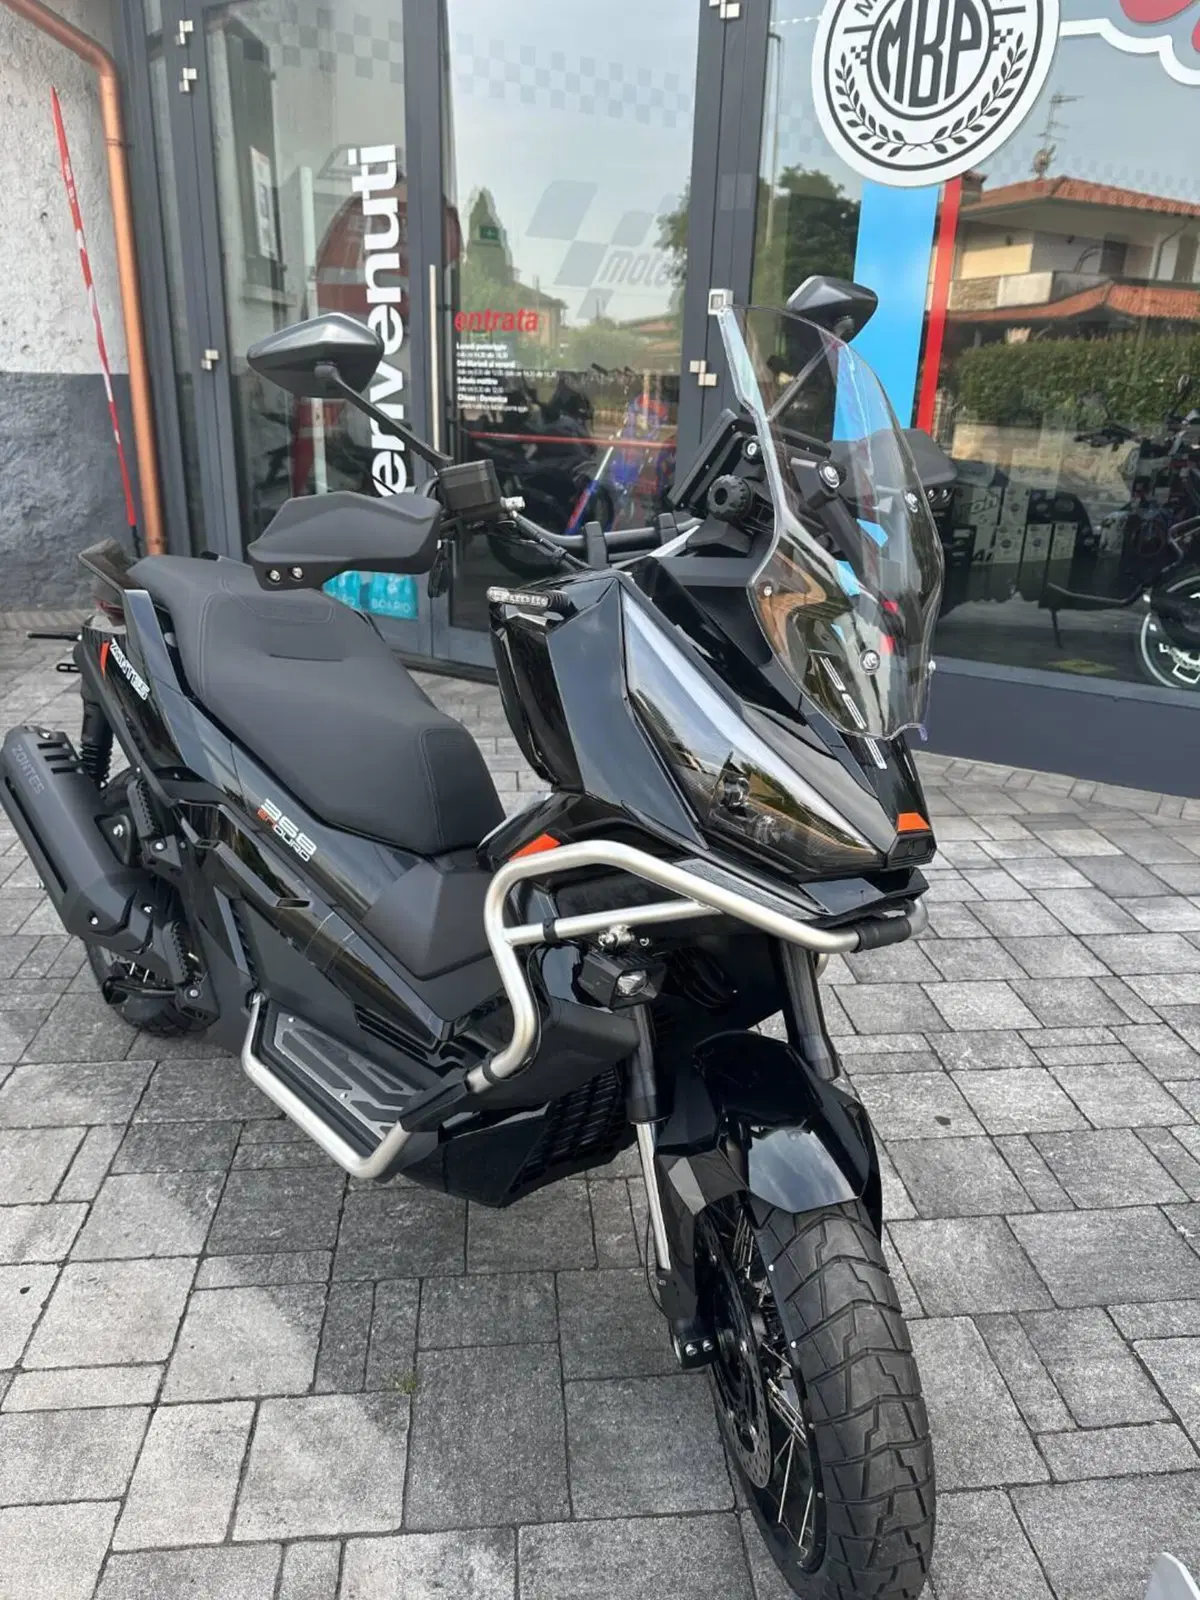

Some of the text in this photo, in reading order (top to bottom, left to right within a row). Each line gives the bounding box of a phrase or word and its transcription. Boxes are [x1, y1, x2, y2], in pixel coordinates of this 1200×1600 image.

[877, 0, 983, 108] MBP
[347, 143, 407, 497] envenuti
[454, 308, 539, 333] entrata
[109, 636, 151, 701] ZONTES
[11, 743, 46, 796] ZONTES
[260, 797, 318, 857] 368
